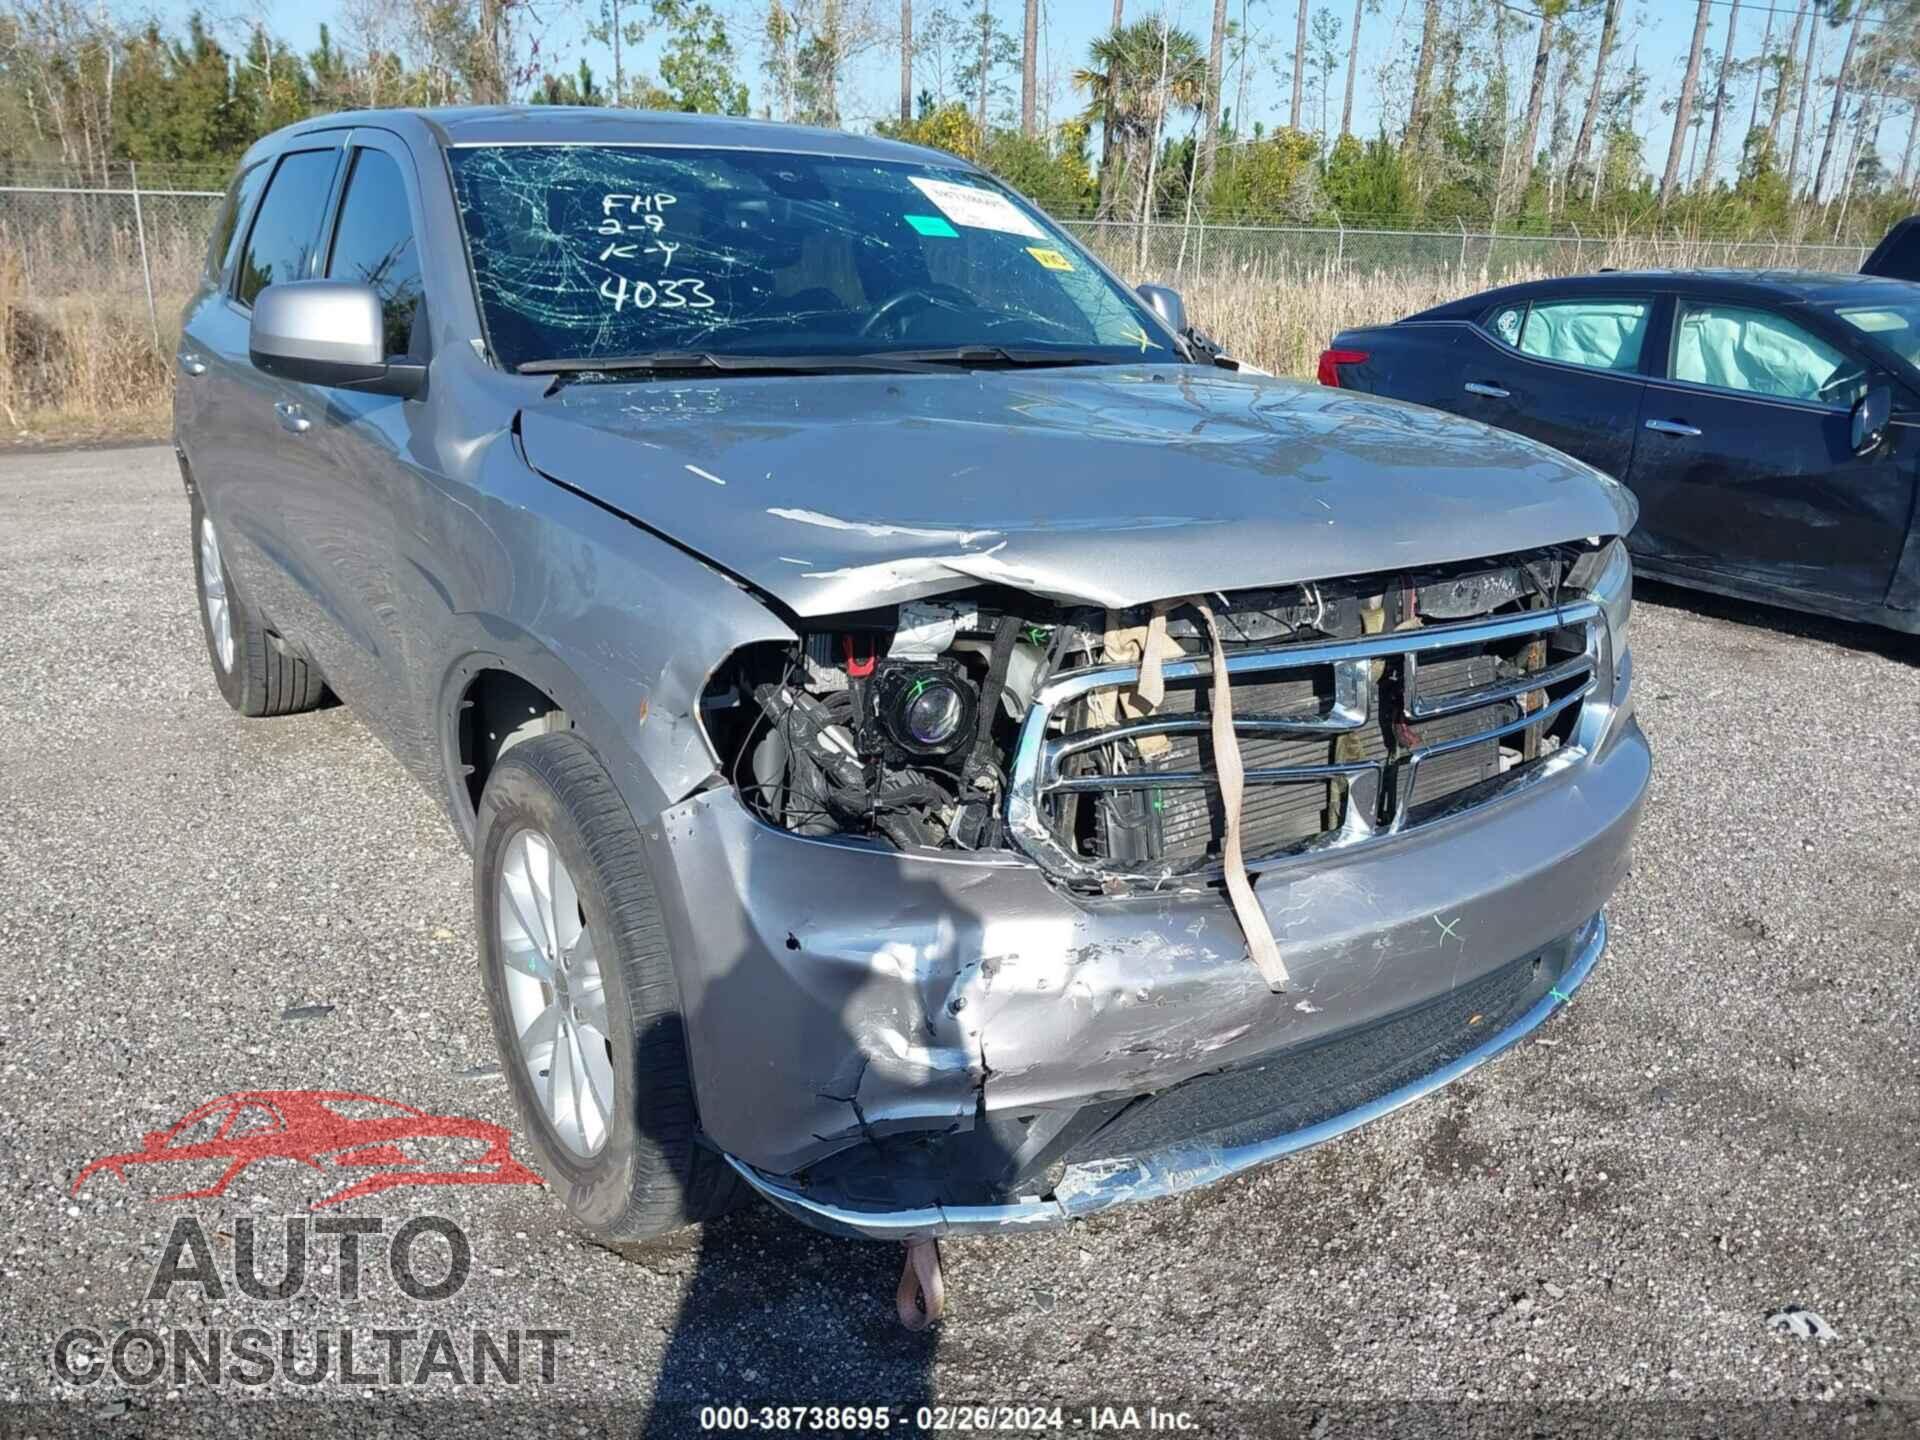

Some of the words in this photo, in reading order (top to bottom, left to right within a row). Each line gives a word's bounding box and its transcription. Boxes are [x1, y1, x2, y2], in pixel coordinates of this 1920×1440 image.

[602, 193, 677, 216] FHP
[598, 215, 665, 234] 2-9
[600, 277, 715, 312] 4033
